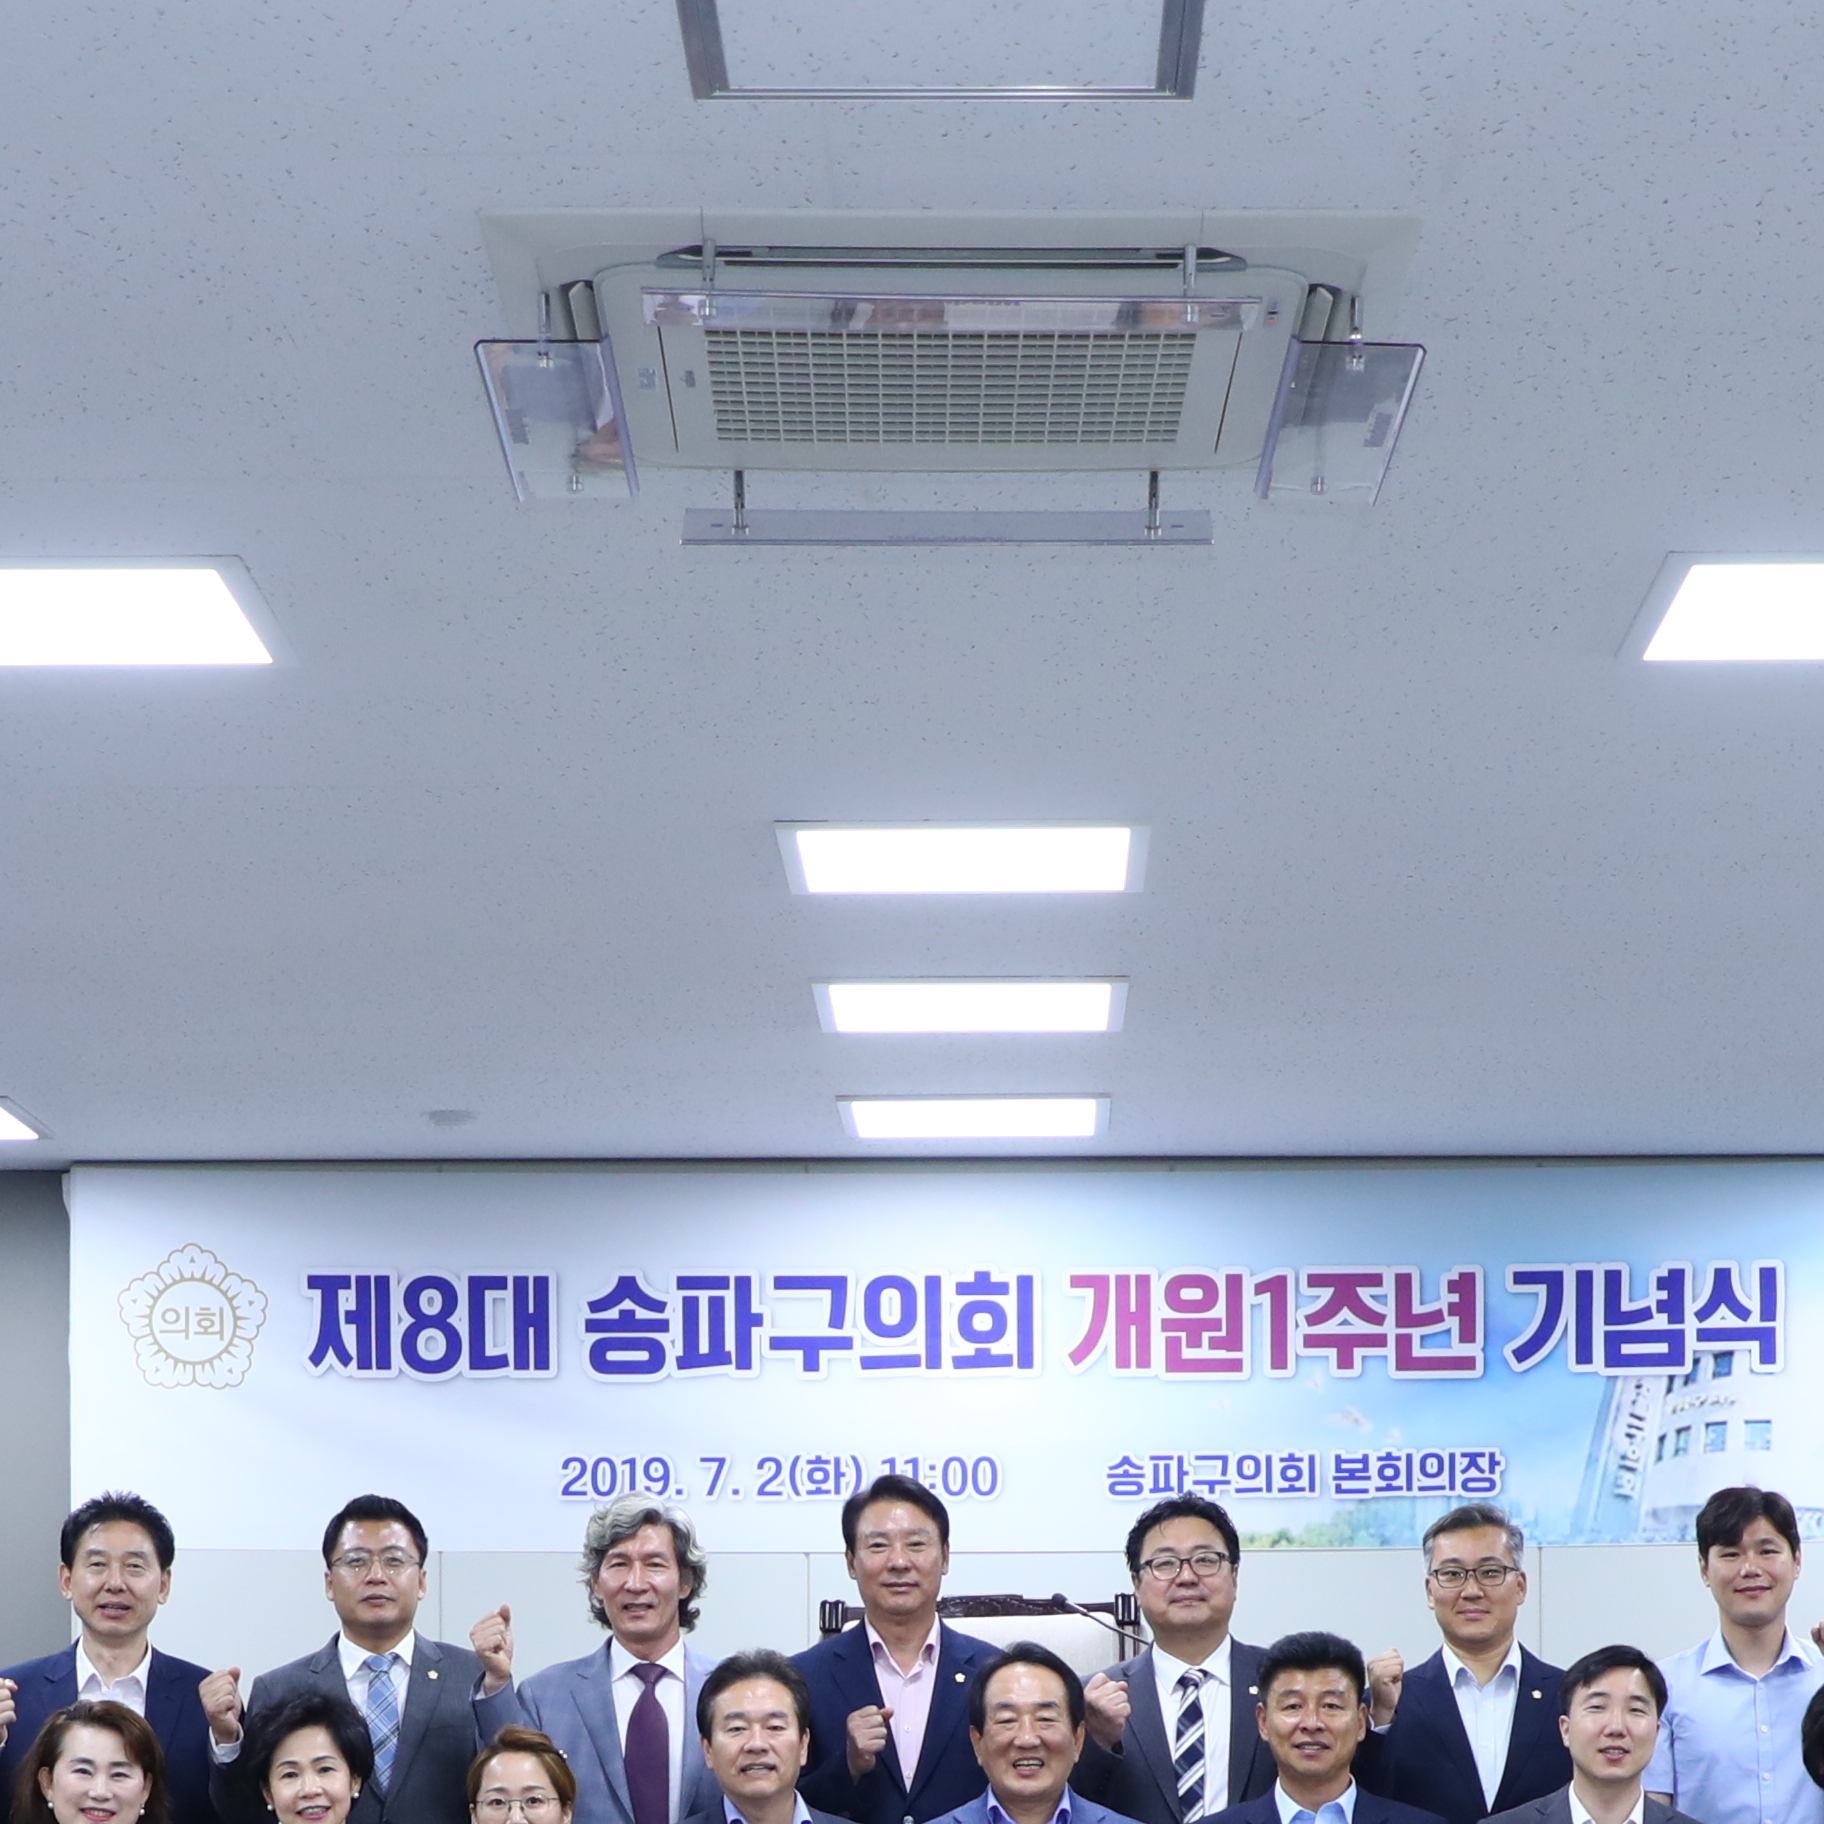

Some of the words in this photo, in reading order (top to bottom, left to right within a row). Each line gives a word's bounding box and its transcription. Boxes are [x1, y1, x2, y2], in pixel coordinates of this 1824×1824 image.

[159, 1306, 225, 1341] 의회
[306, 1275, 551, 1375] 제8대
[584, 1271, 1035, 1376] 송파구의회
[1066, 1270, 1478, 1374] 개원1주년
[1508, 1260, 1779, 1369] 기념식
[560, 1456, 685, 1497] 2019.
[1106, 1453, 1317, 1497] 송파구의회
[1332, 1450, 1501, 1495] 본회의장
